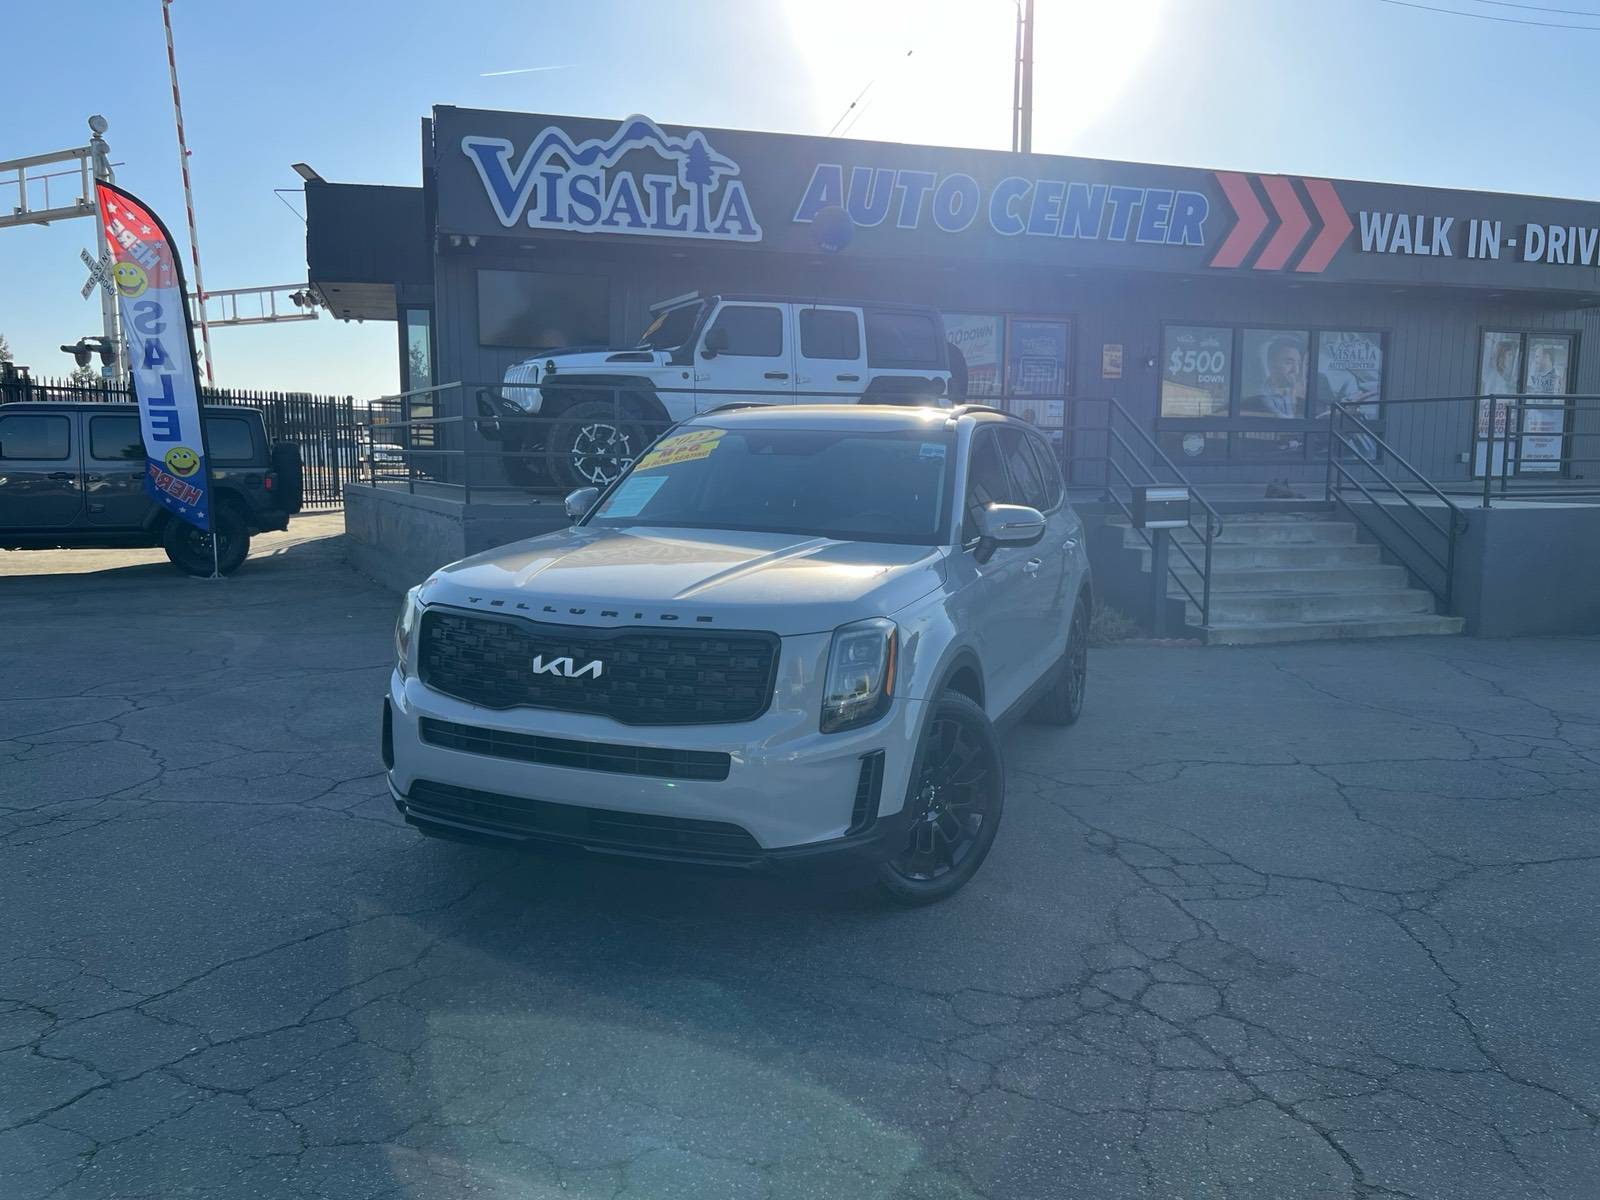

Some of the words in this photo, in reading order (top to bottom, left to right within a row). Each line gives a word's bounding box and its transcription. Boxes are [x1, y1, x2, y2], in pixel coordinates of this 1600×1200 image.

[462, 134, 761, 241] VISALIA
[793, 163, 981, 232] AUTO
[989, 176, 1209, 246] CENTER
[1359, 211, 1454, 257] WALK
[1467, 219, 1502, 259] IN
[1523, 223, 1600, 266] DRIV
[1169, 346, 1225, 375] $500
[1198, 375, 1225, 383] DOWN
[468, 597, 713, 623] TELLURIDE
[533, 654, 602, 680] KIA
